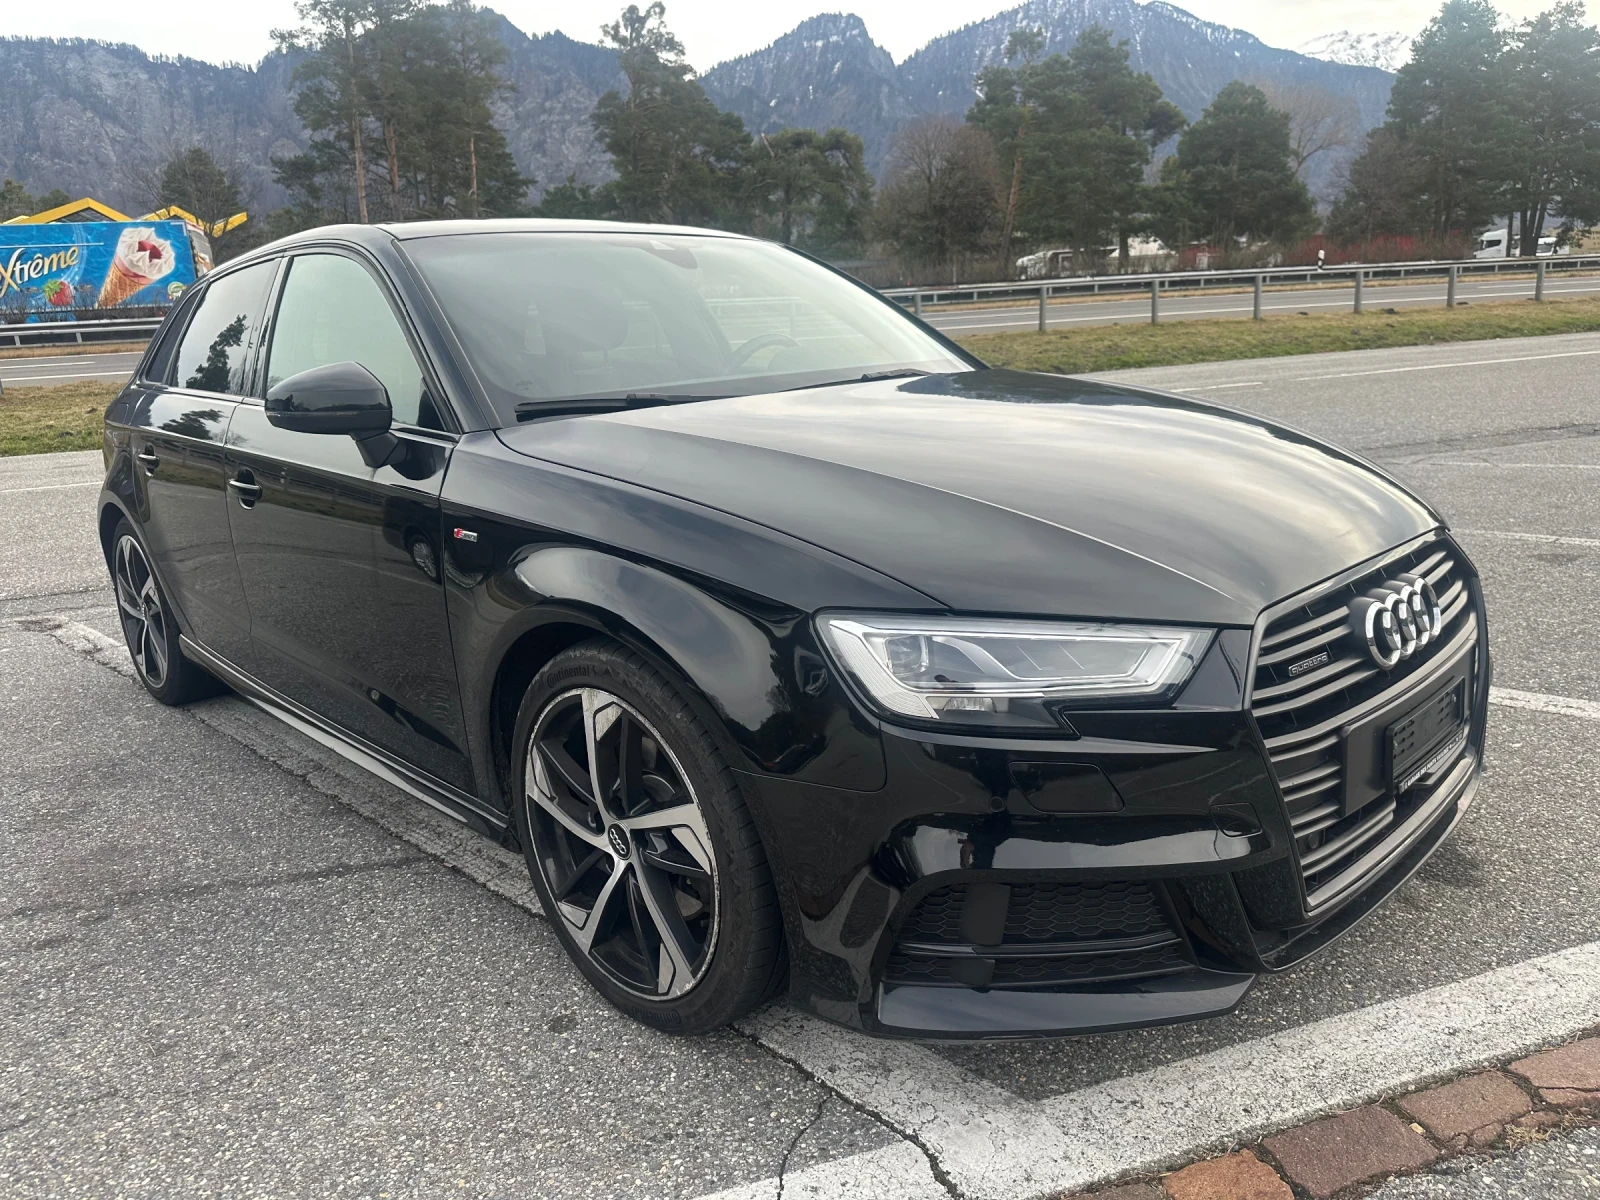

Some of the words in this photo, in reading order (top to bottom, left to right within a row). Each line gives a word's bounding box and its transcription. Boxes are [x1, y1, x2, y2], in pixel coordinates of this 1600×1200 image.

[0, 247, 79, 298] Xtrême
[1290, 654, 1328, 675] quattro
[547, 665, 591, 689] Continental
